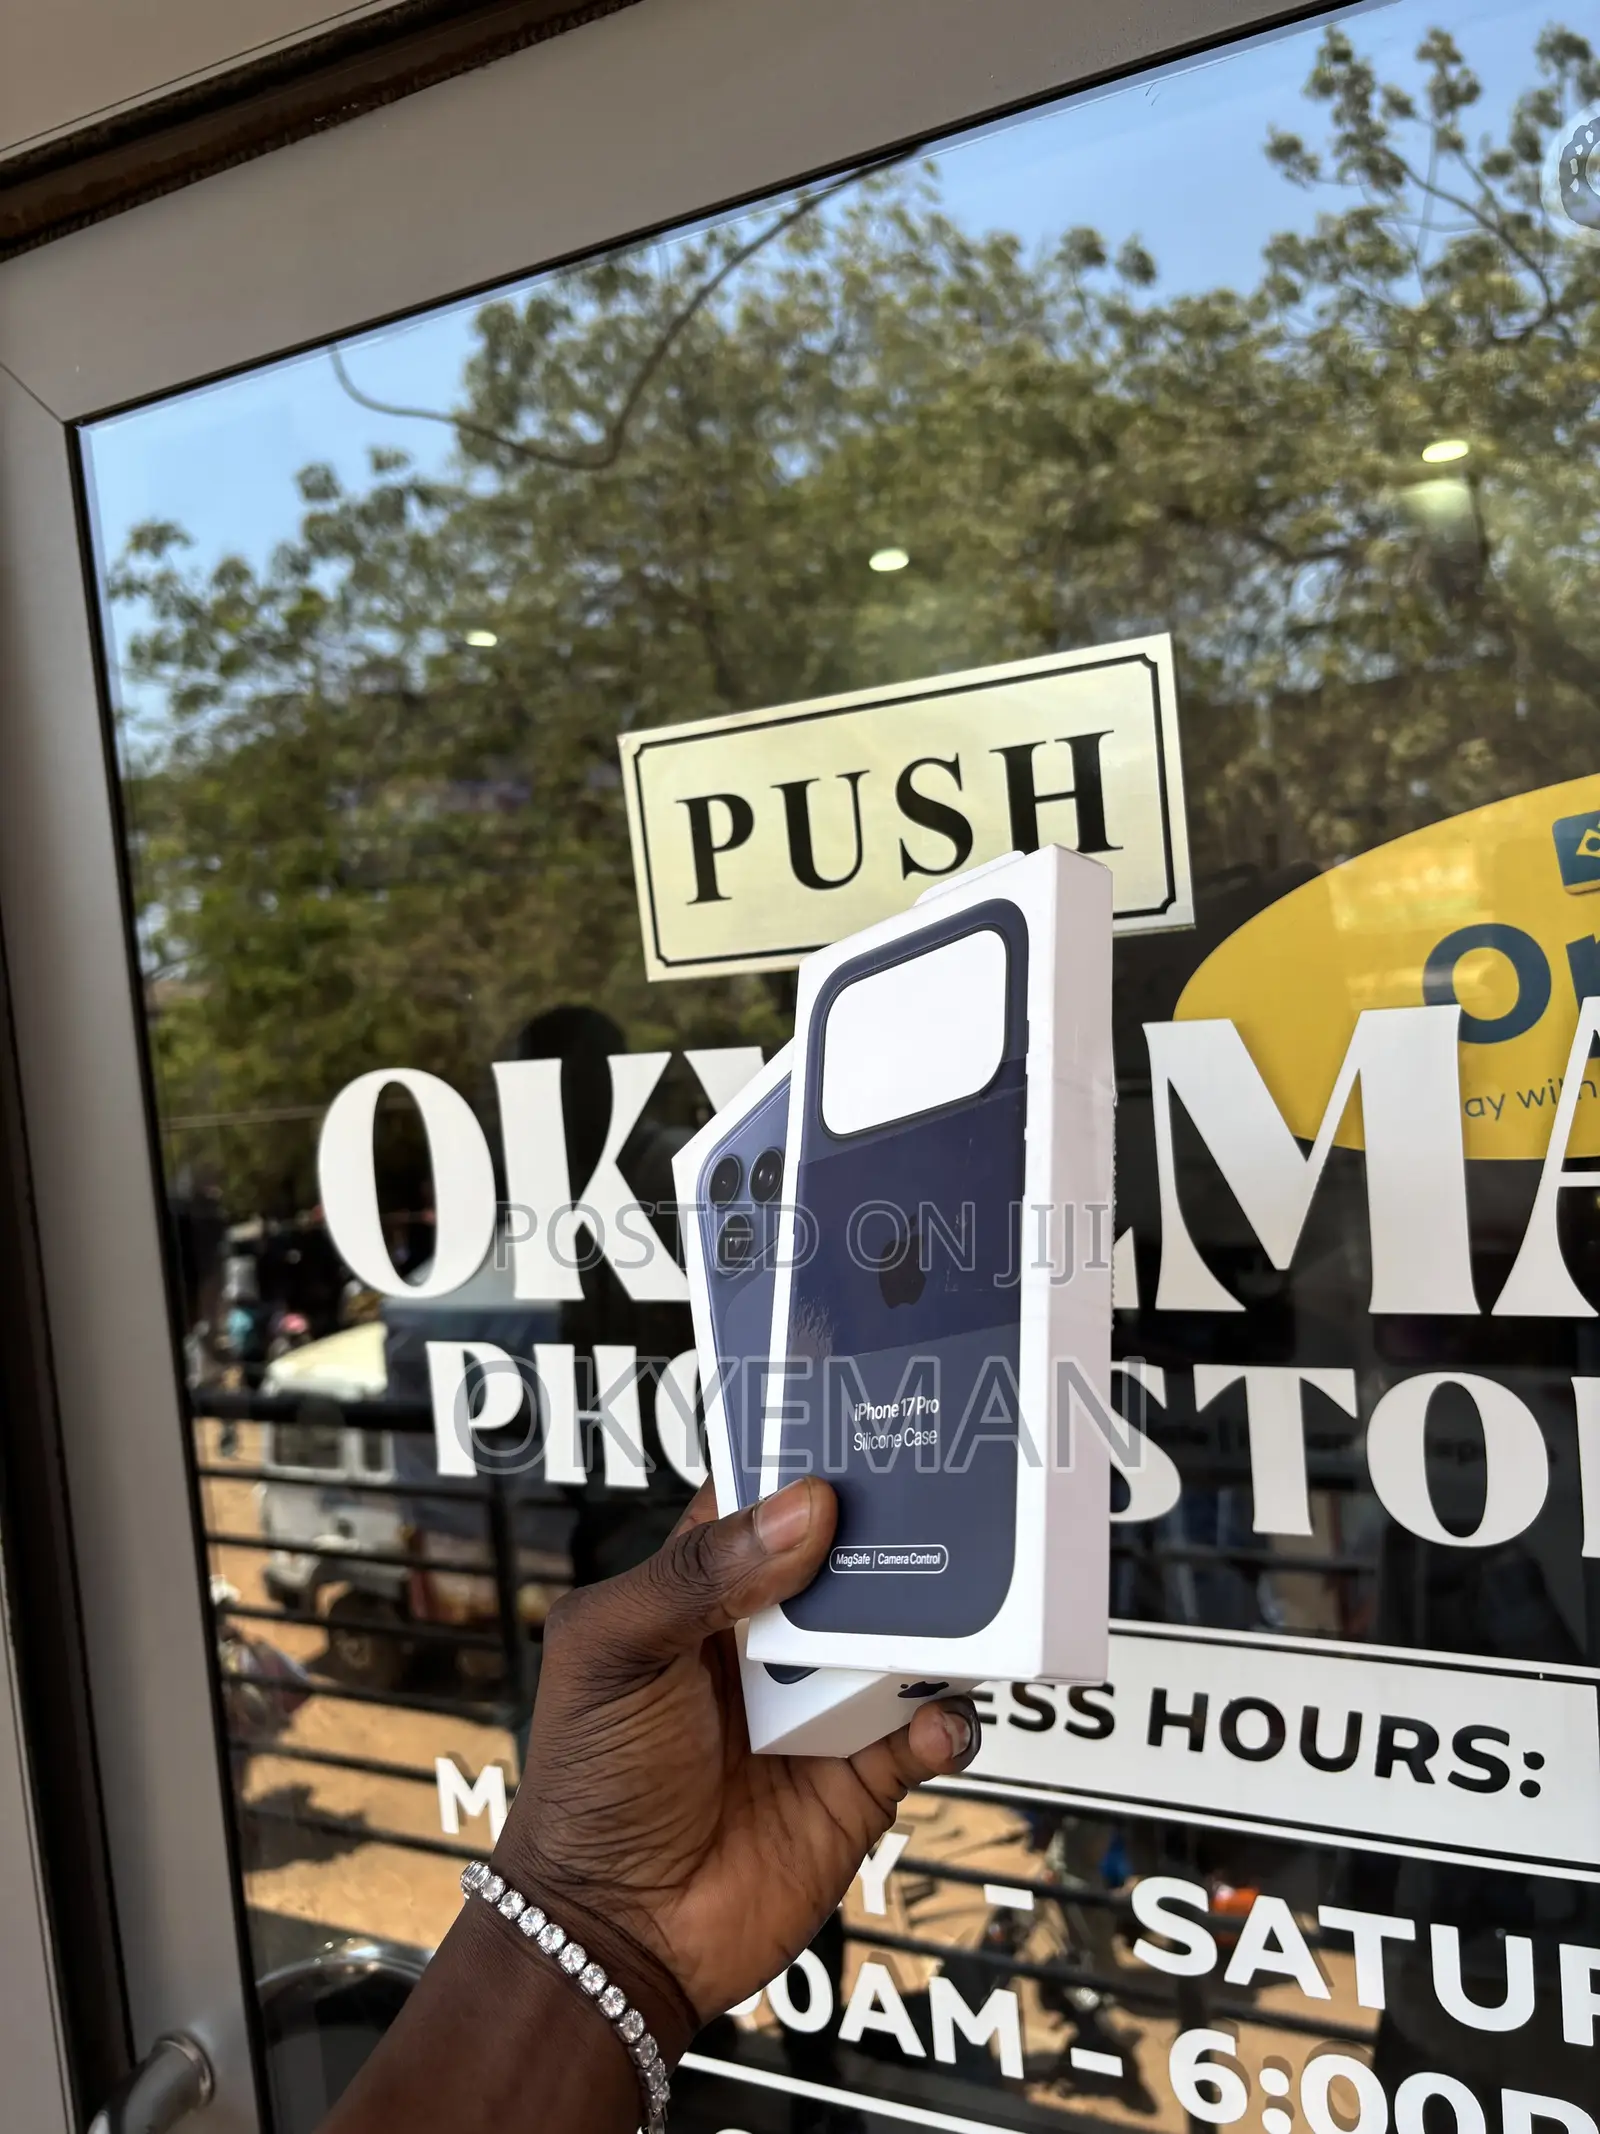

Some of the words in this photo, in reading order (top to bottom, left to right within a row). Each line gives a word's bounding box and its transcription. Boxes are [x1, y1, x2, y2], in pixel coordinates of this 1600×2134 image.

[676, 730, 1124, 906] PUSH
[854, 1402, 899, 1422] iPhone
[901, 1397, 916, 1417] 17
[917, 1395, 940, 1416] Pro
[853, 1432, 902, 1451] Silicone
[904, 1428, 938, 1448] Case
[1109, 1360, 1600, 1558] STO
[835, 1553, 871, 1568] MagSafe
[877, 1552, 909, 1566] Camera
[909, 1550, 942, 1566] Control
[1147, 1687, 1545, 1798] HOURS:
